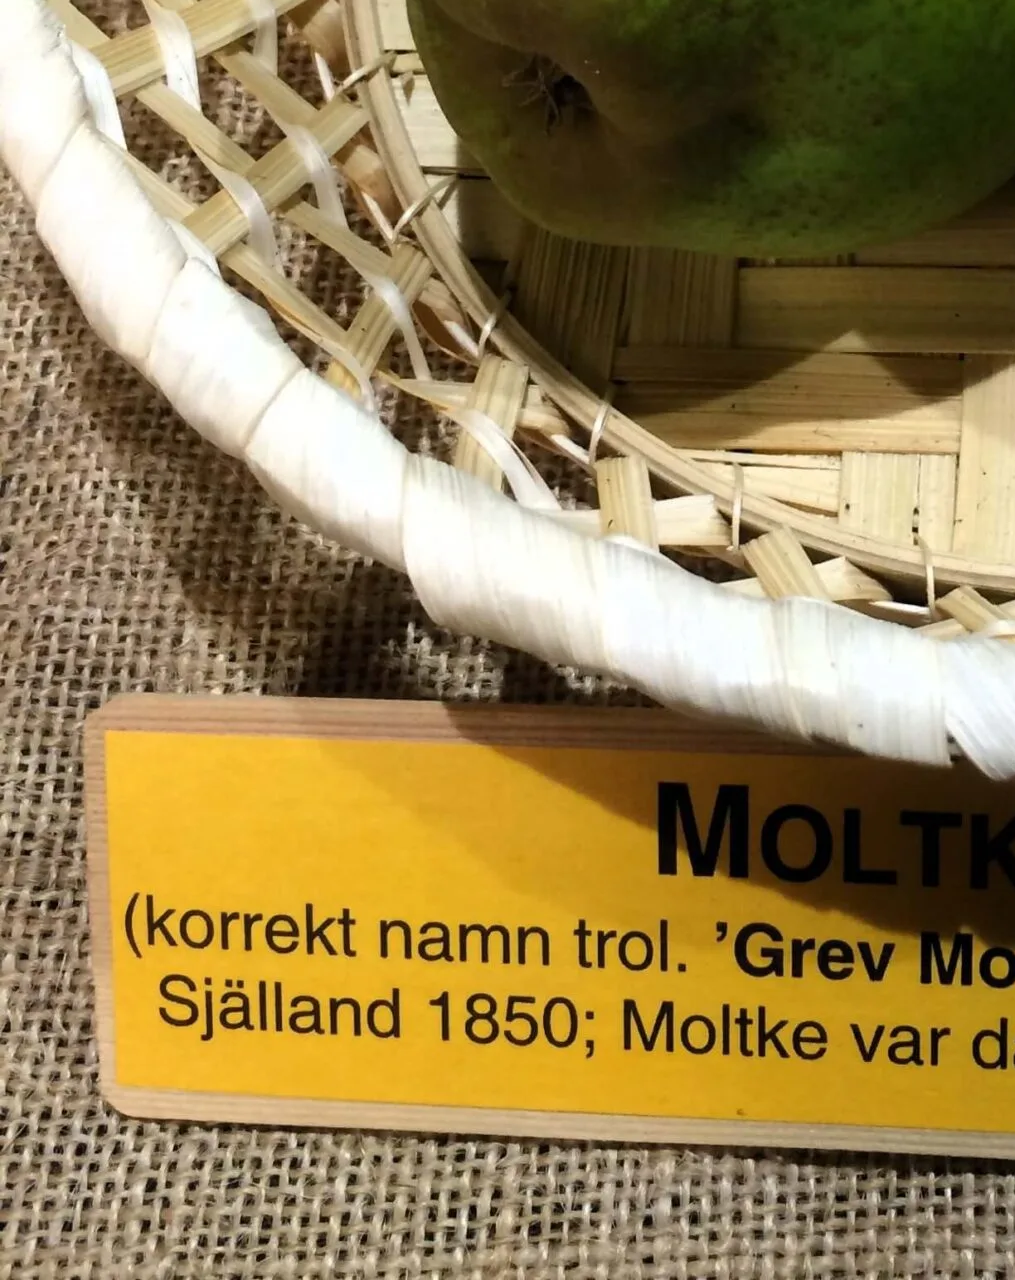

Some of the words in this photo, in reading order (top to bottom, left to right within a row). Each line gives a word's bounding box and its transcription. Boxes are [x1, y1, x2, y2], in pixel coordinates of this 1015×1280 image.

[123, 892, 354, 959] (korrekt
[380, 920, 550, 967] namn
[577, 917, 687, 974] trol.
[158, 974, 401, 1042] Själland
[429, 990, 597, 1059] 1850;
[622, 998, 828, 1062] Moltke
[850, 1022, 950, 1069] var
